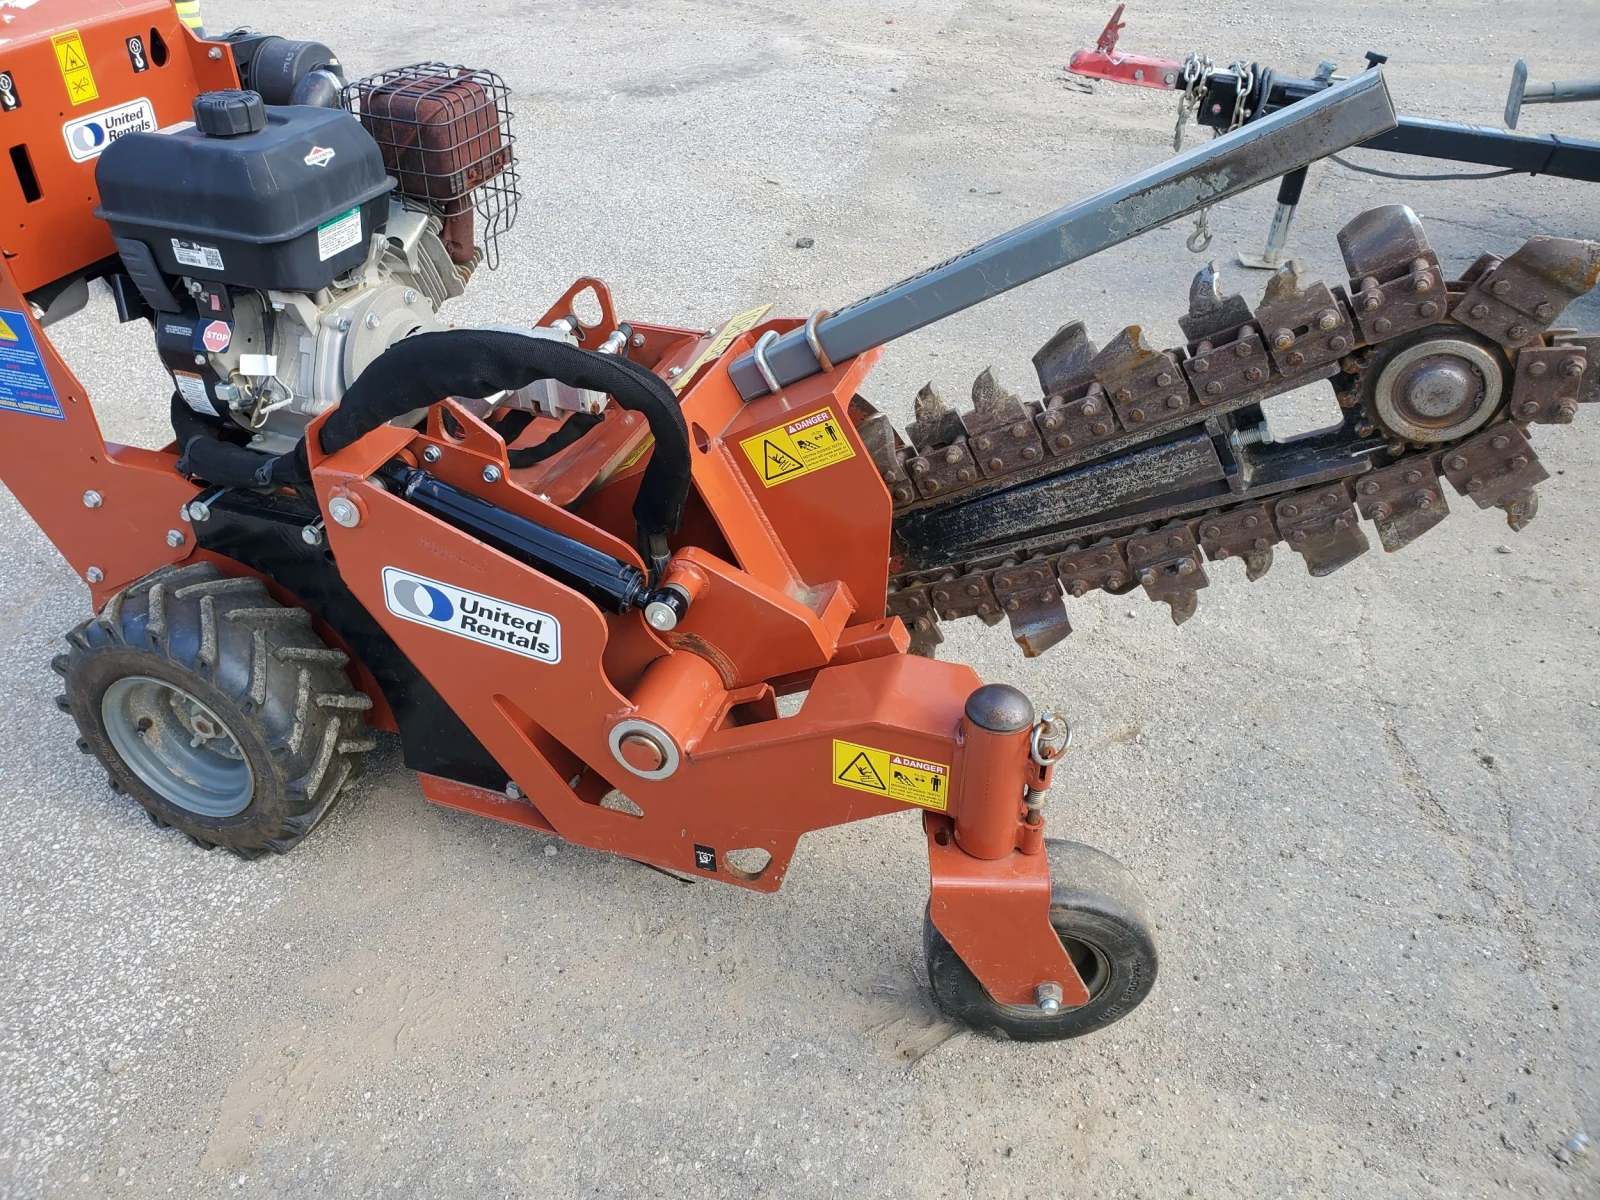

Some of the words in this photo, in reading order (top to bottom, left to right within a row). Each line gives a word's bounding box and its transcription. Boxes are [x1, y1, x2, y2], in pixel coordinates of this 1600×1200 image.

[105, 106, 143, 128] United
[108, 120, 150, 142] Rentals
[206, 330, 228, 341] STOP
[796, 412, 829, 431] DANGER
[460, 596, 542, 634] United
[461, 614, 550, 654] Rentals
[903, 758, 943, 774] DANGER
